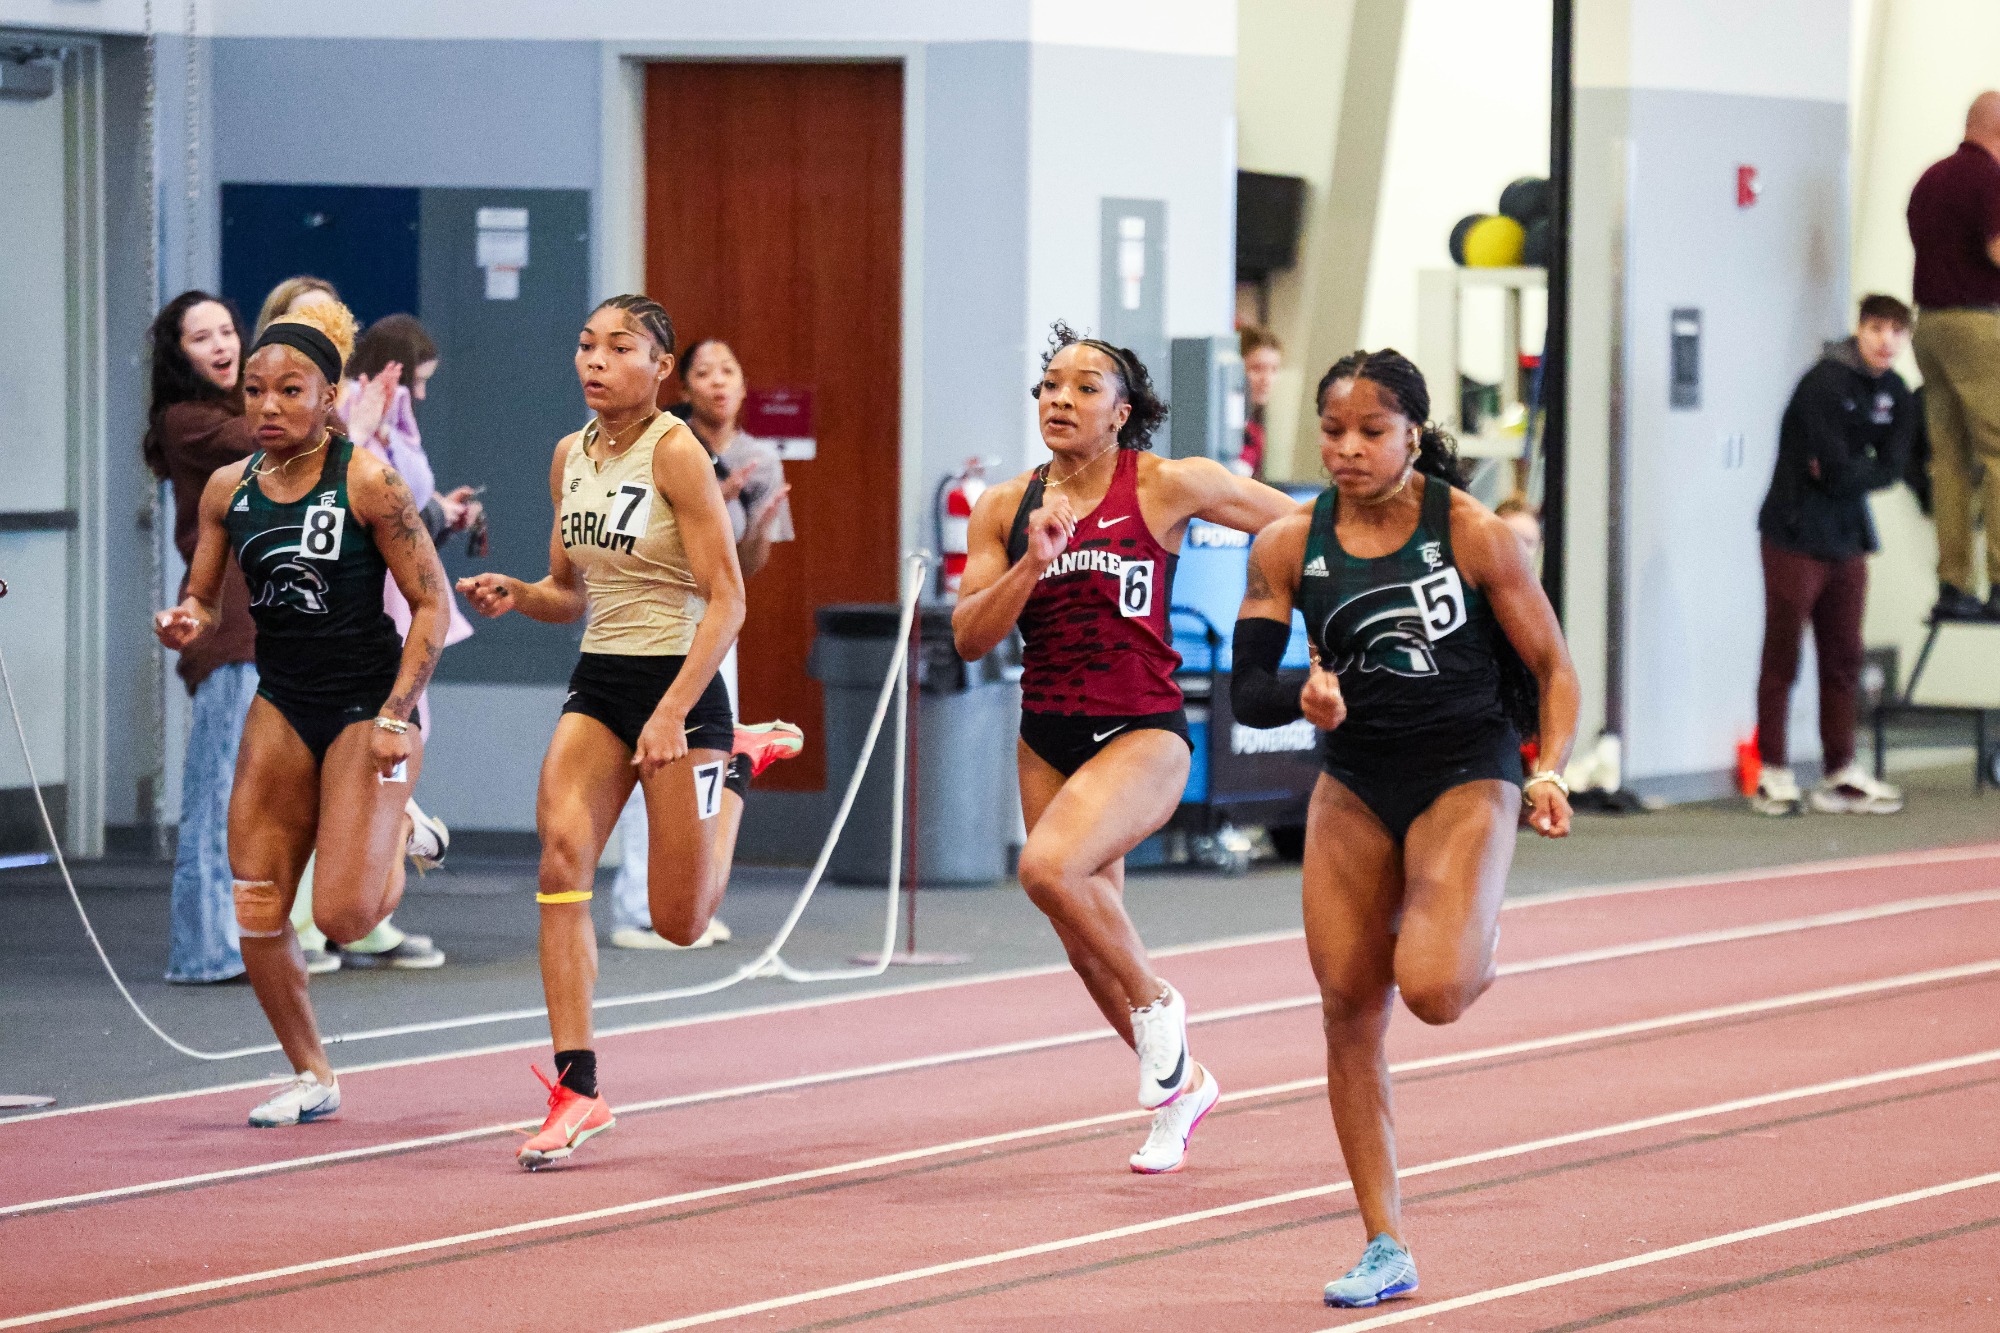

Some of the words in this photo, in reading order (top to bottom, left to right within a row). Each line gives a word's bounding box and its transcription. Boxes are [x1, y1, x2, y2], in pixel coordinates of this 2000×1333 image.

[616, 486, 647, 531] 7
[307, 511, 336, 555] 8
[1039, 550, 1122, 580] ANOKE
[1125, 565, 1148, 612] 6
[1421, 577, 1457, 631] 5
[699, 767, 718, 813] 7
